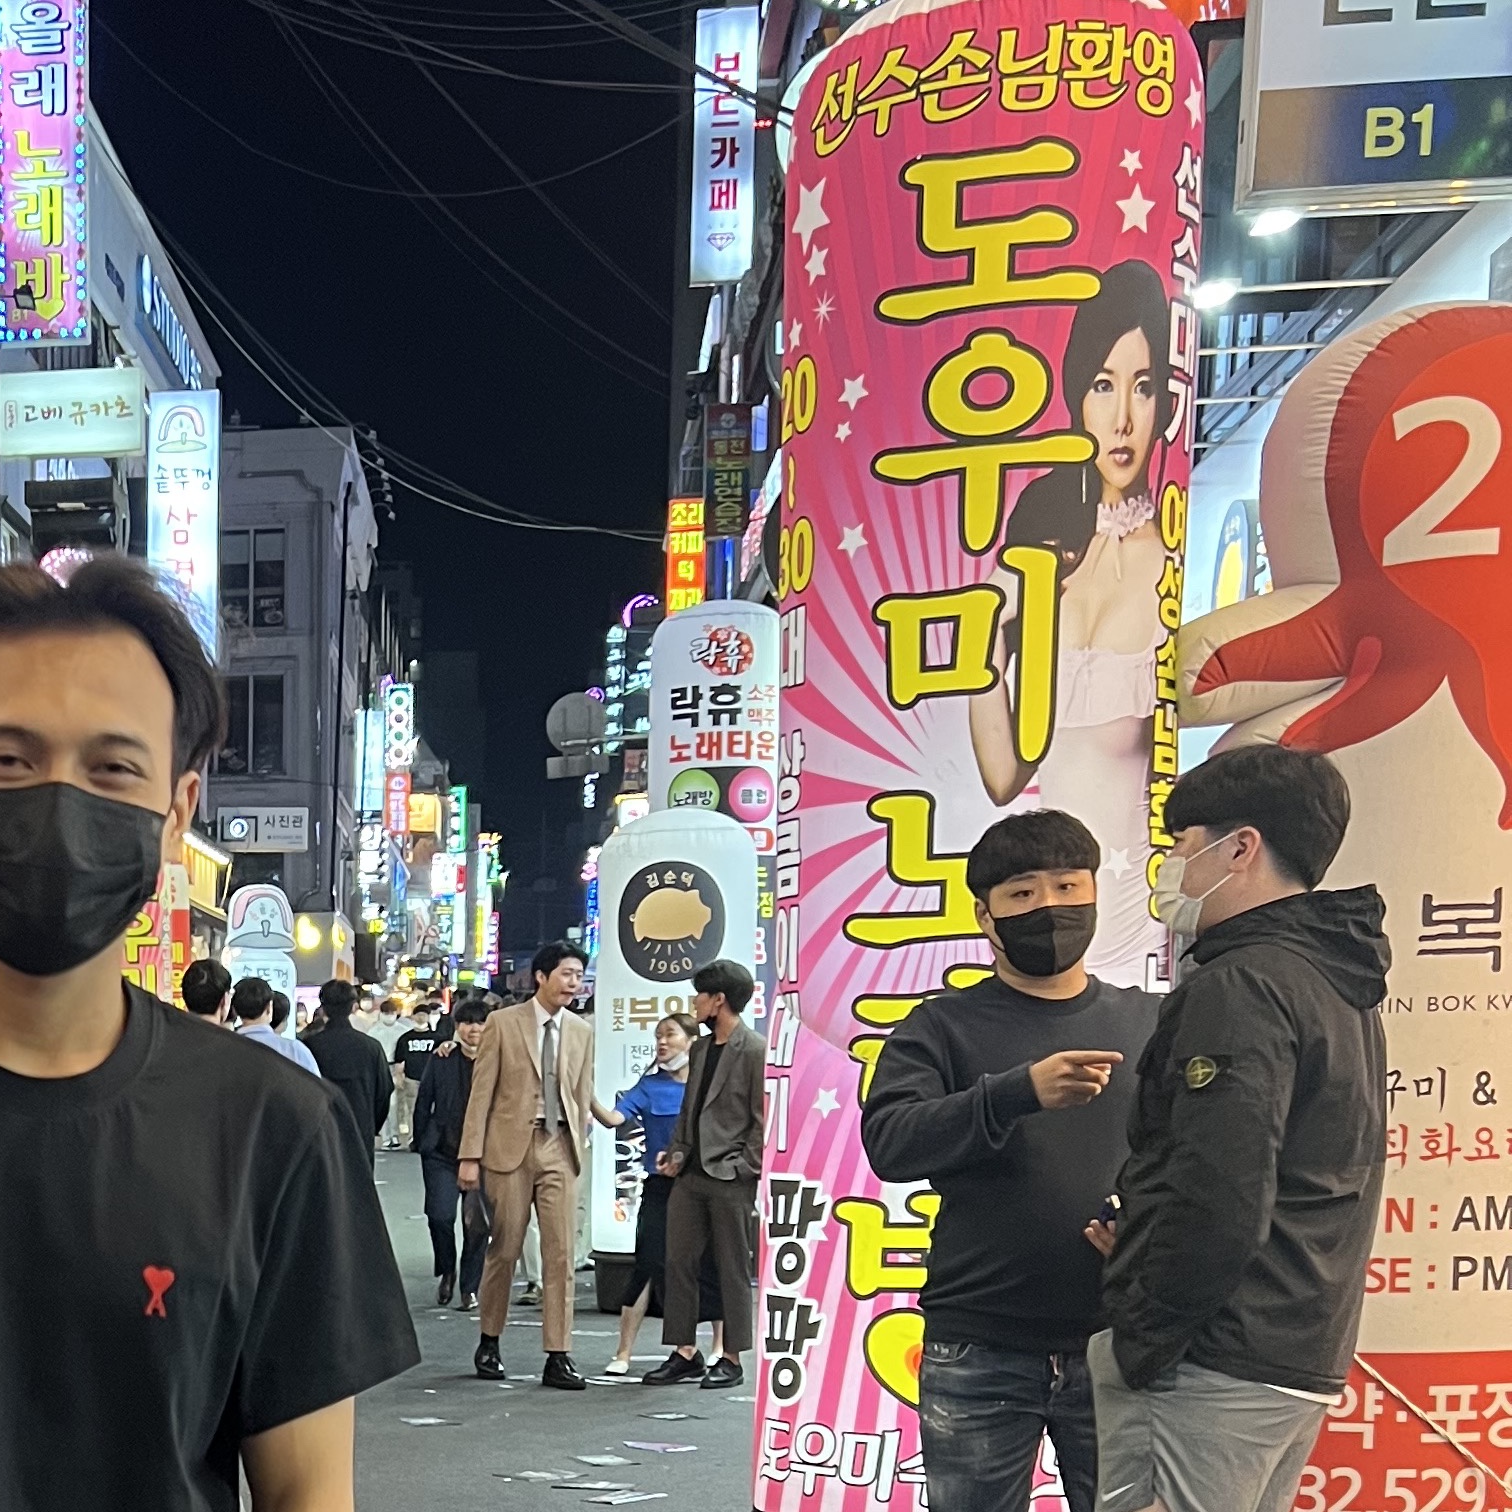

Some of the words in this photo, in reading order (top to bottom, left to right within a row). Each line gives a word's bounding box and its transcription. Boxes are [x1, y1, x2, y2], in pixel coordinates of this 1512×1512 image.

[811, 20, 1177, 158] 선수손님환영
[1364, 103, 1435, 159] B1
[1381, 395, 1503, 567] 2
[669, 682, 743, 728] 락휴
[669, 729, 776, 765] 노래타운
[264, 813, 304, 829] 사진관
[648, 955, 694, 975] 1960
[1426, 995, 1477, 1013] BOK
[1471, 1070, 1499, 1108] &
[765, 1174, 833, 1406] 팡팡
